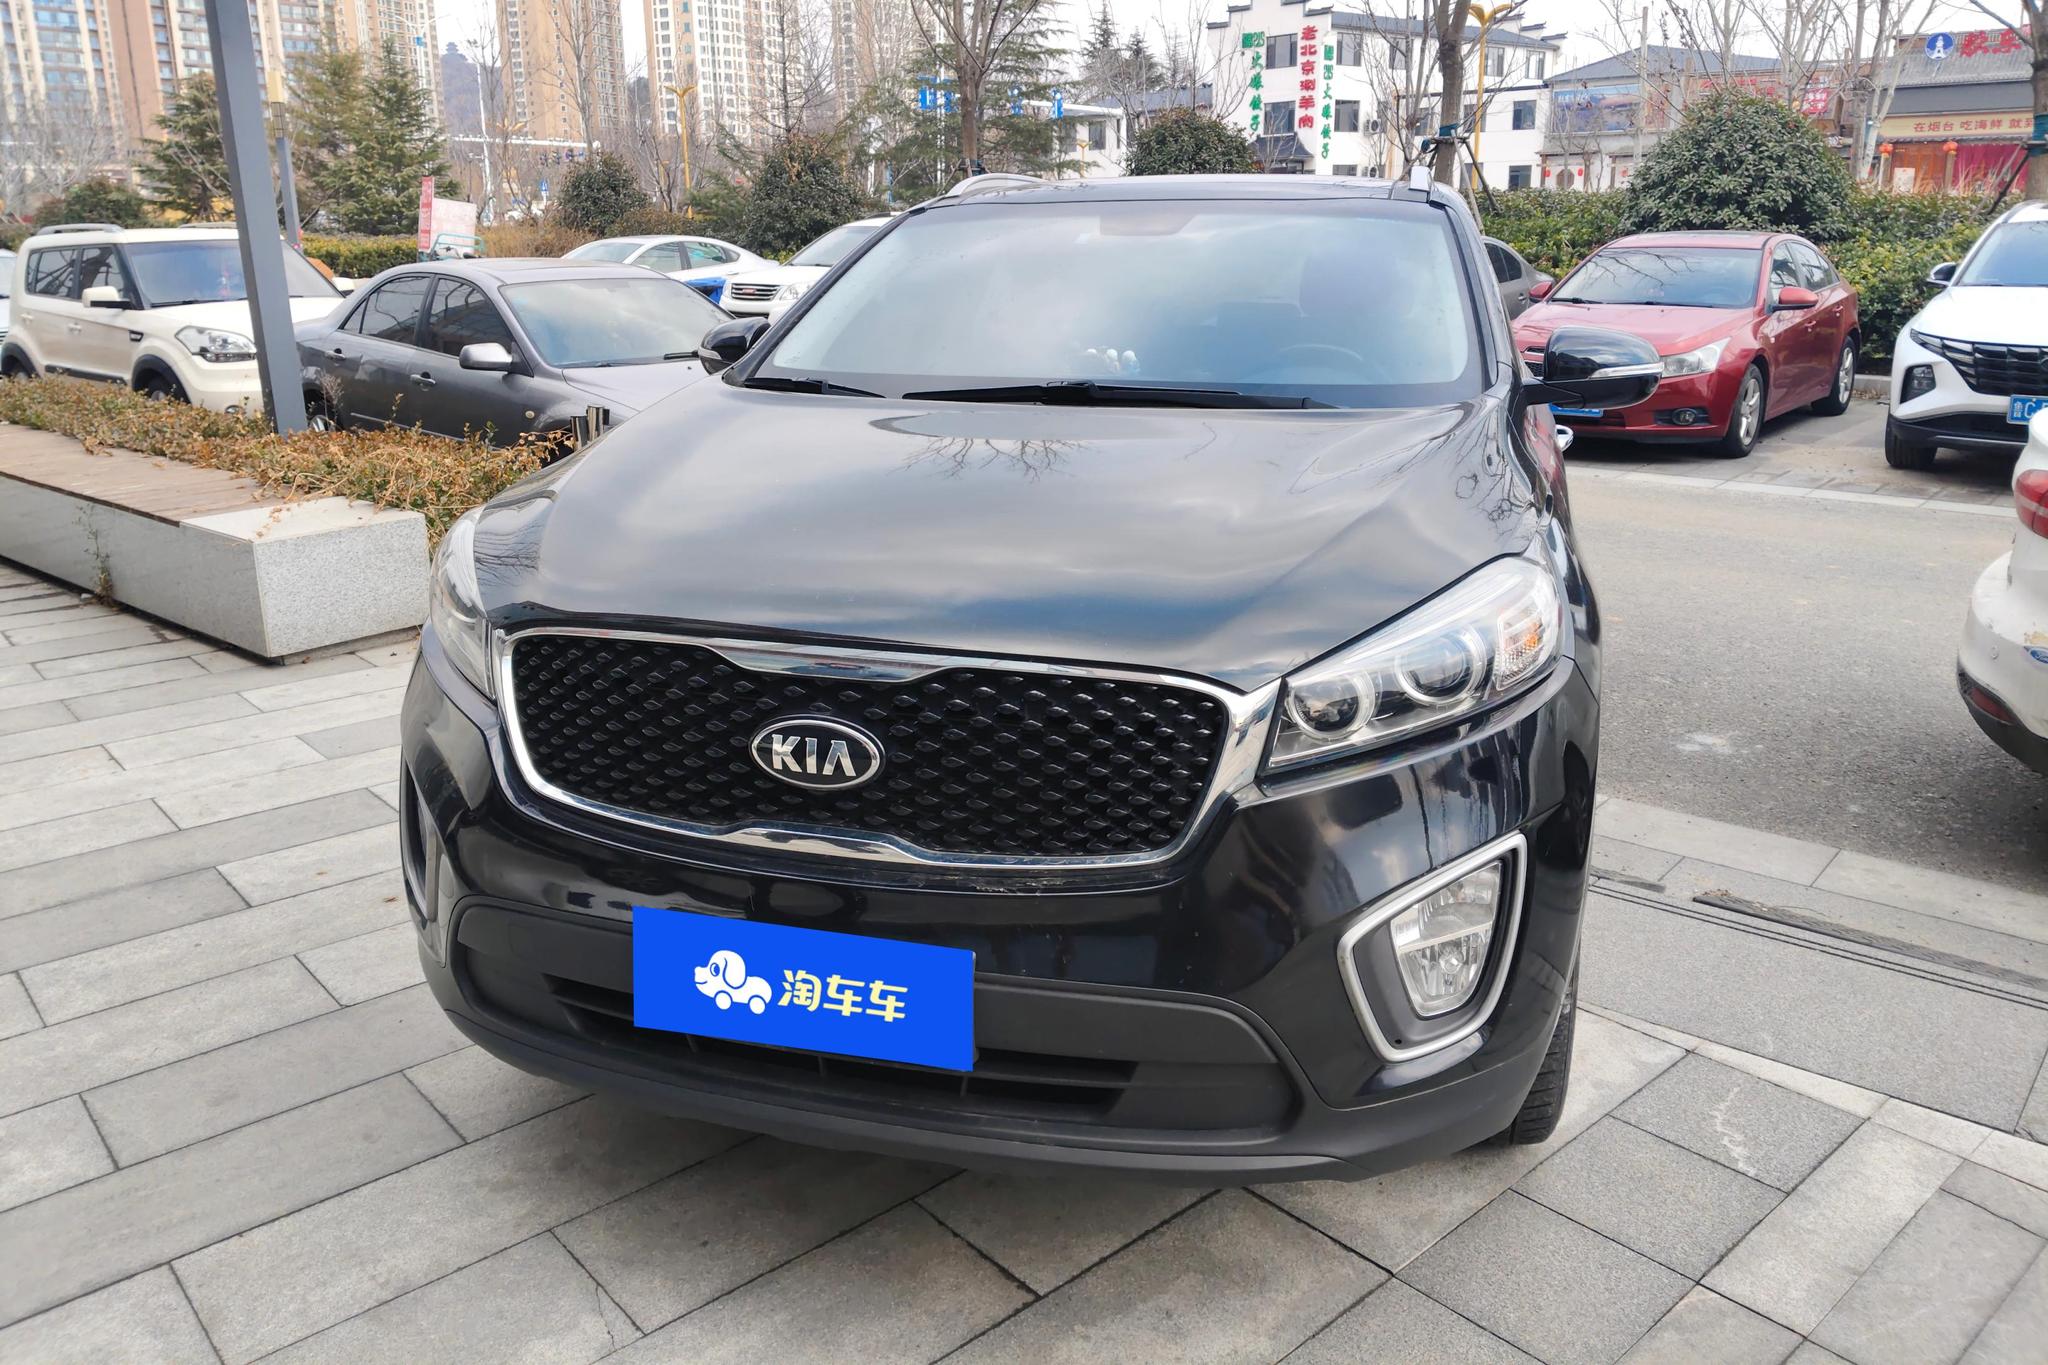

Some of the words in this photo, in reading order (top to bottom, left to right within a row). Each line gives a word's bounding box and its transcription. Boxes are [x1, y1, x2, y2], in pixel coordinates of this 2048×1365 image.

[1299, 25, 1318, 129] 老北京涮羊肉
[1914, 121, 1954, 132] 在烟台
[1960, 119, 2002, 131] 吃海鲜
[771, 733, 857, 777] KIA
